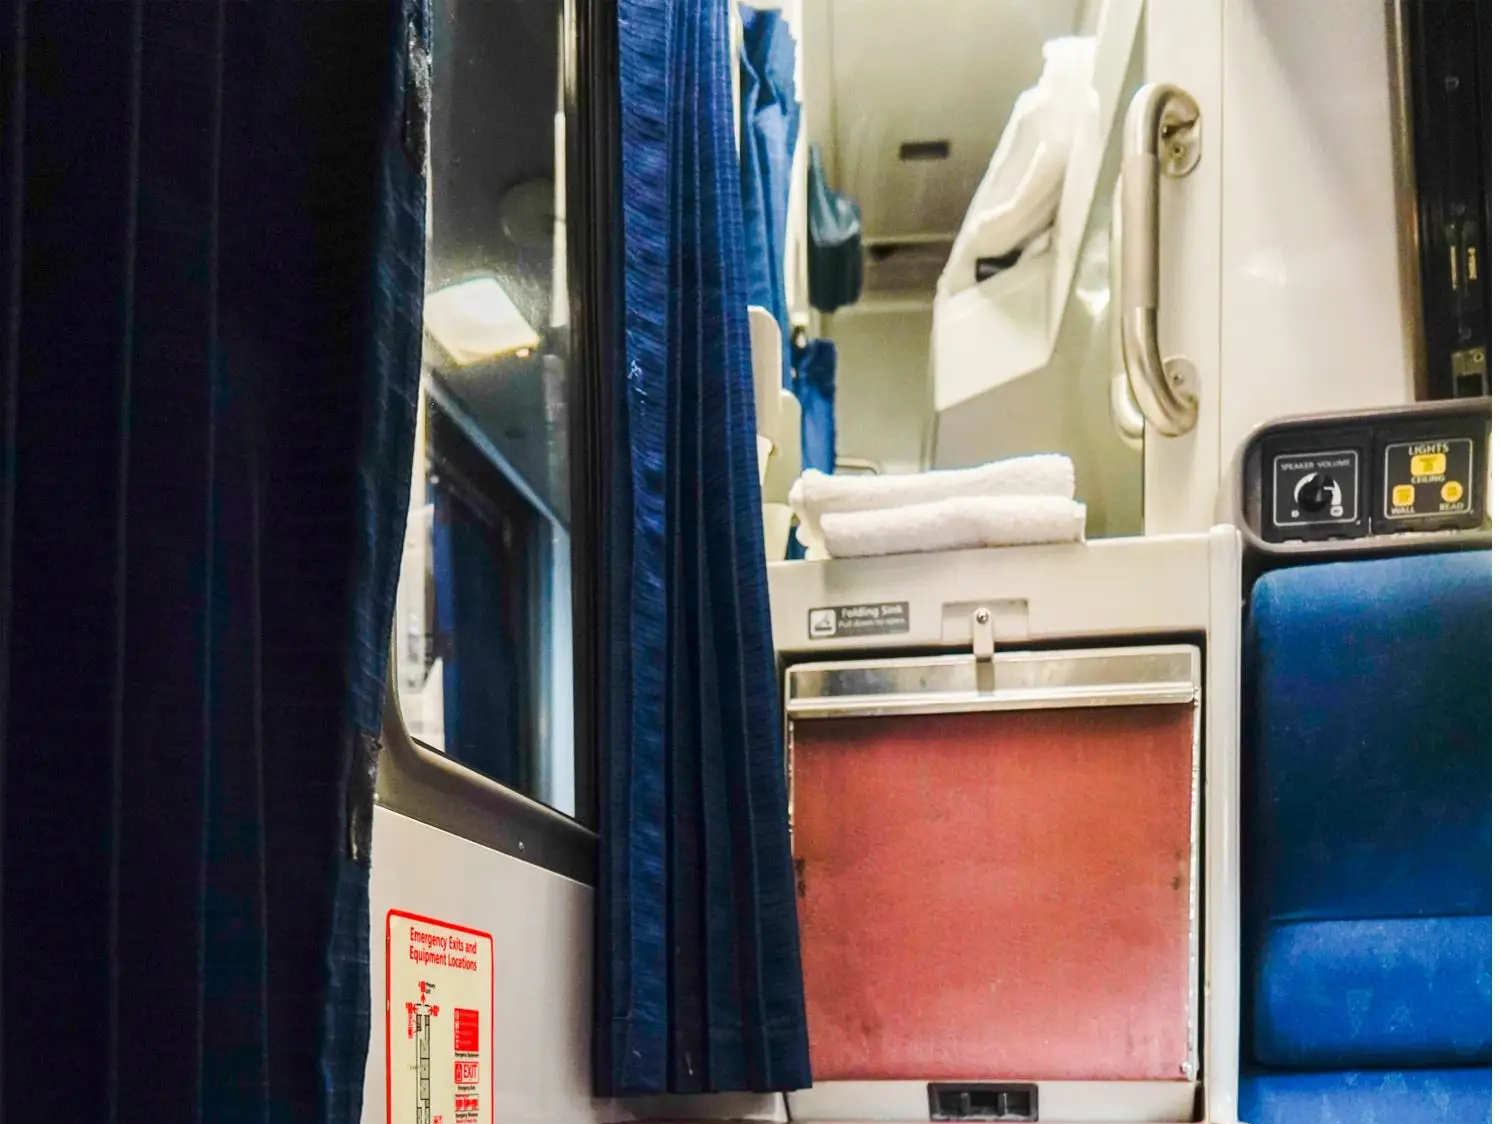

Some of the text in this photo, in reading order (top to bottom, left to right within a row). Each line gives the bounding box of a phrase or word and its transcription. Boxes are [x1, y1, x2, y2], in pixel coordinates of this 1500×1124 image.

[1408, 443, 1449, 456] LIGHTS
[1281, 459, 1350, 470] SPEAKER VOLUME
[1411, 475, 1445, 484] CEILING
[1391, 505, 1414, 514] WALL
[1439, 502, 1464, 511] READ
[842, 605, 903, 618] Folding Sink
[410, 927, 477, 954] Emergency Exits and
[409, 945, 477, 971] Equipment Locations
[463, 1064, 477, 1078] EXIT
